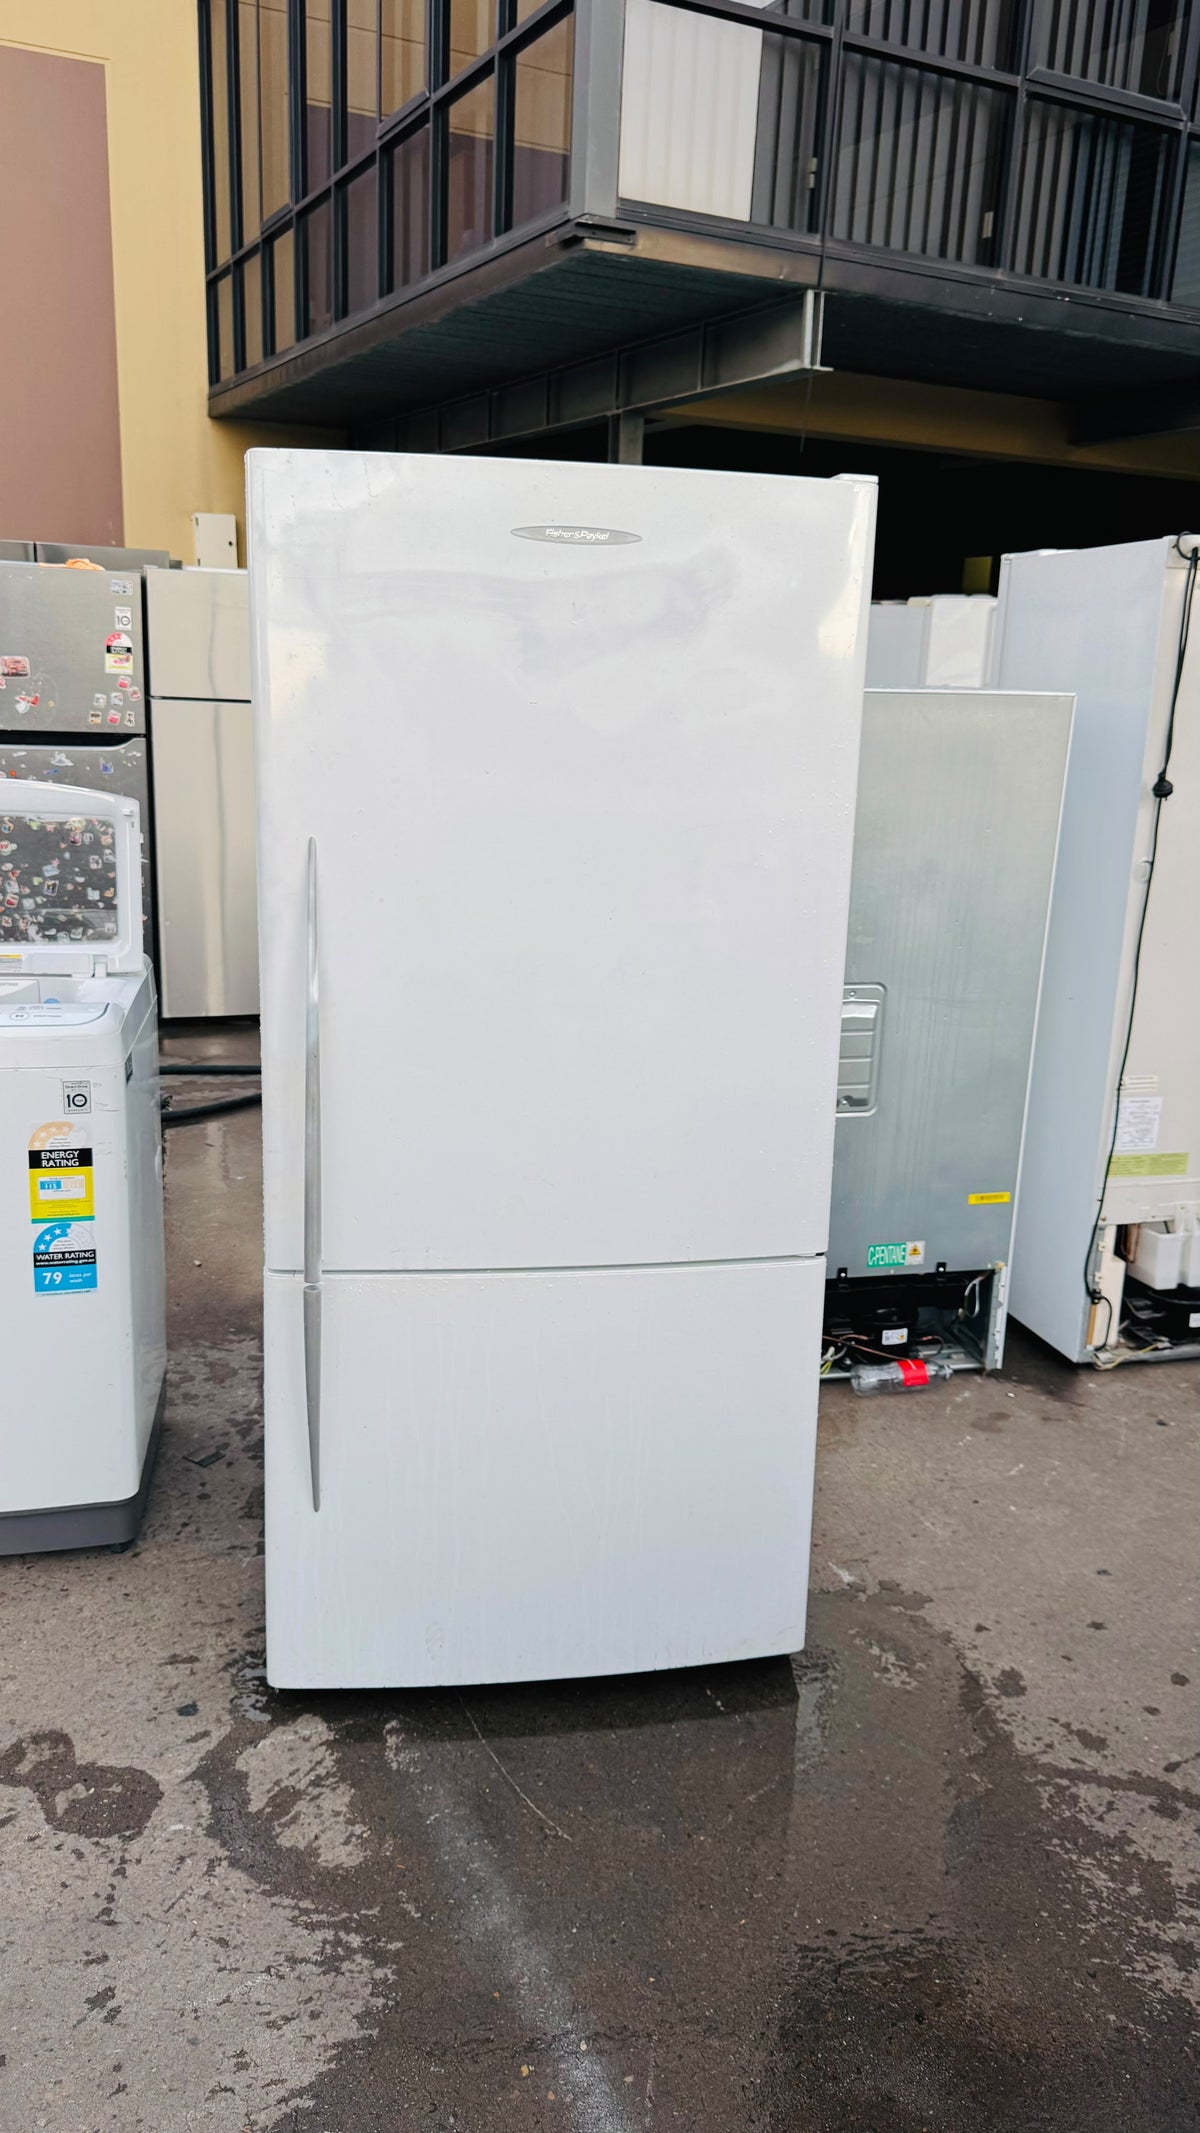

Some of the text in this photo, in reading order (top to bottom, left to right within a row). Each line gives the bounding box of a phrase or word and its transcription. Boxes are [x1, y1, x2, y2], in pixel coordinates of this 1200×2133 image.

[66, 1093, 88, 1108] 10
[41, 1150, 80, 1160] ENERGY
[41, 1158, 80, 1168] RATING
[36, 1250, 95, 1261] WATER RATING
[42, 1271, 63, 1285] 79
